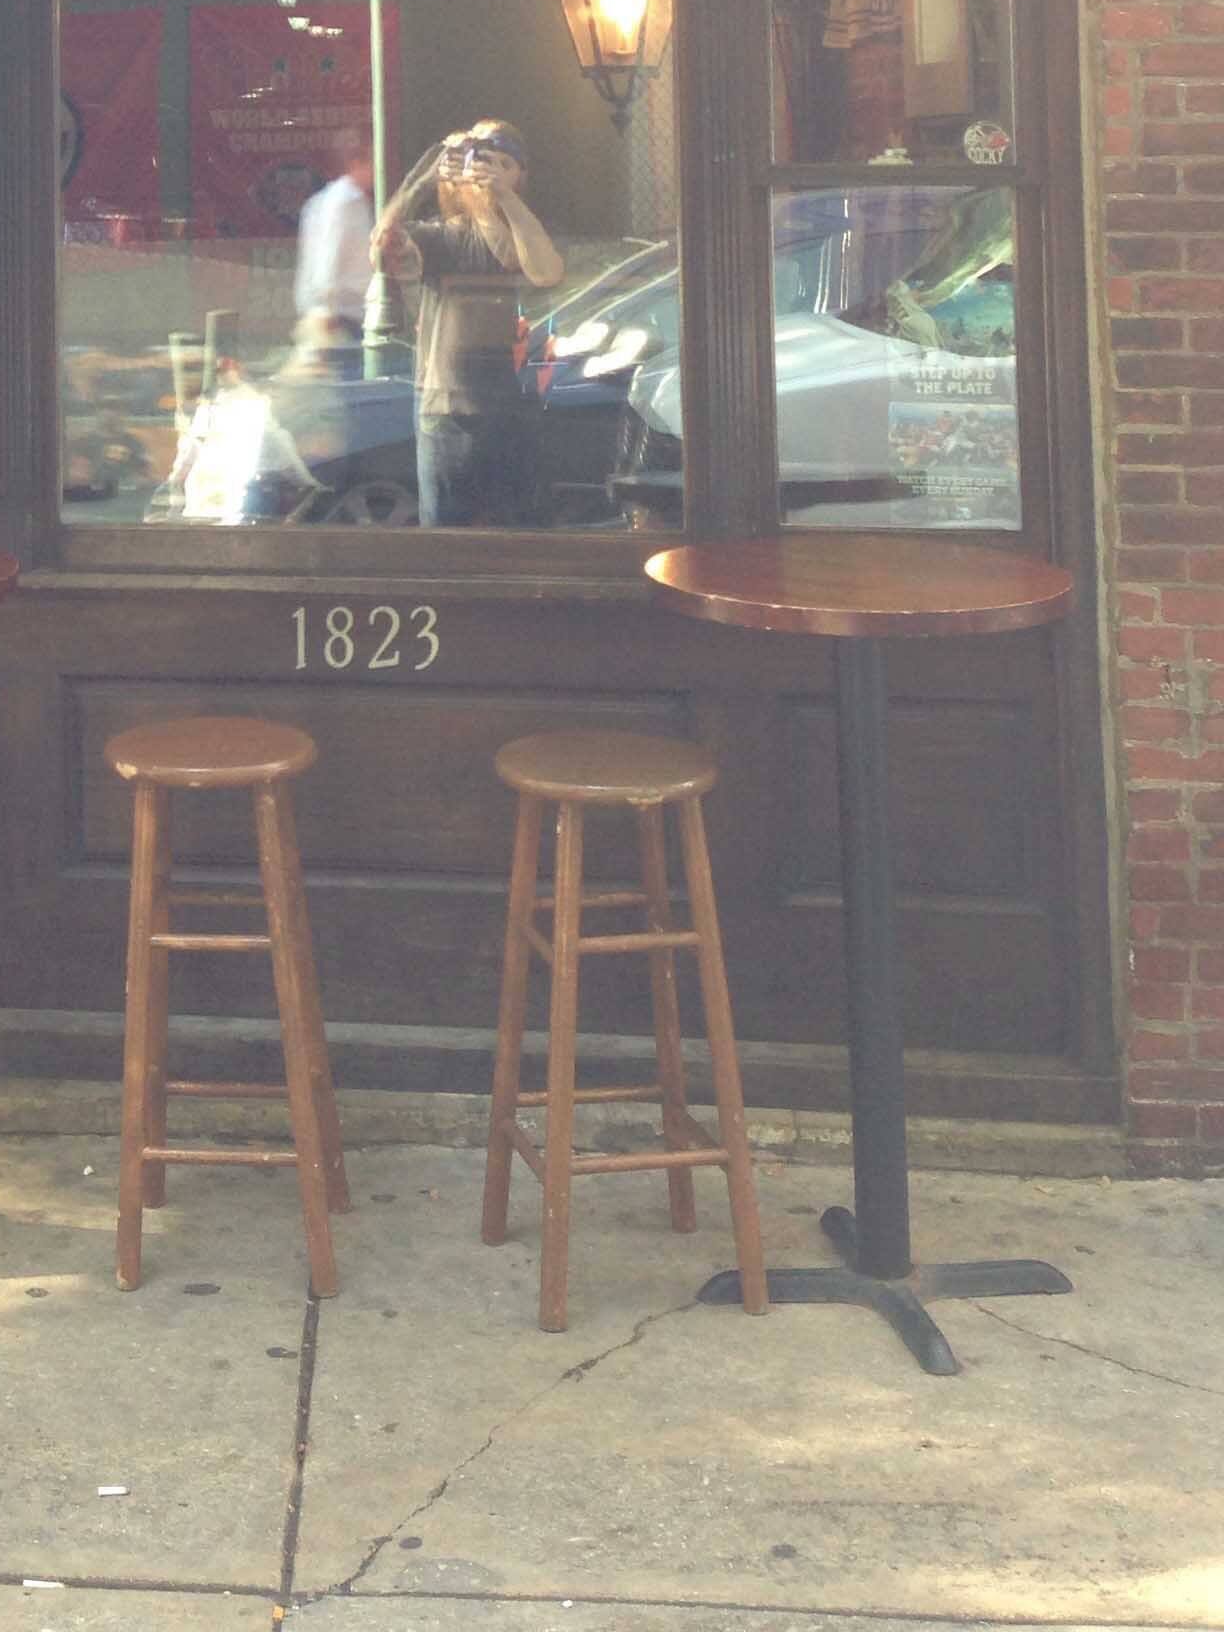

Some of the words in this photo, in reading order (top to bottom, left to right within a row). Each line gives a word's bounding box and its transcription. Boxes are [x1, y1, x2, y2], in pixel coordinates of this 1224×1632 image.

[914, 382, 944, 394] THE
[947, 382, 993, 395] PLATE
[292, 605, 440, 670] 1823
